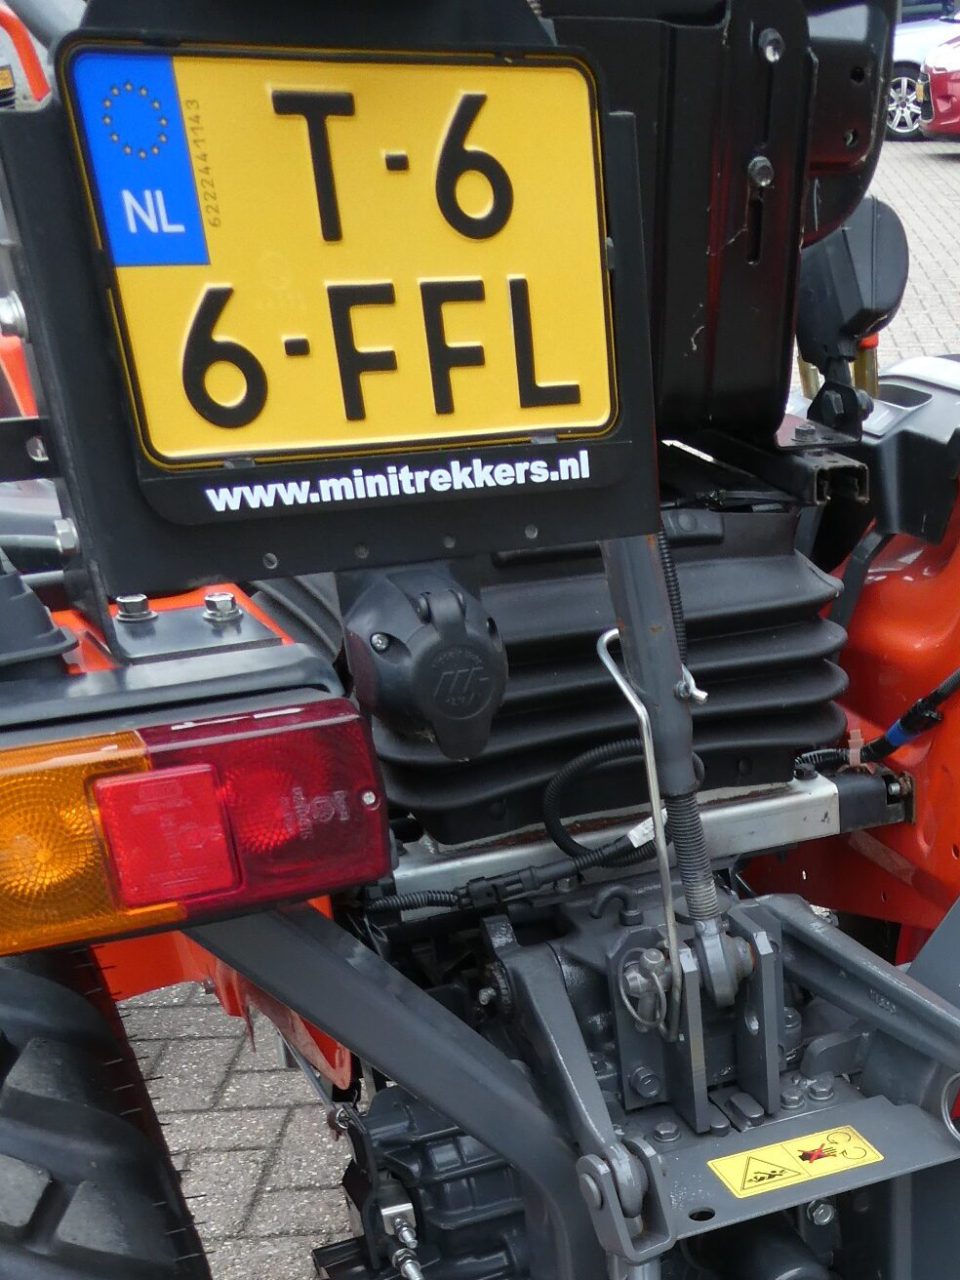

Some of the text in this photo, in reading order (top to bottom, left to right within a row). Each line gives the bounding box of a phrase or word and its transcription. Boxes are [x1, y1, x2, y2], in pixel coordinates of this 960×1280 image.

[121, 189, 186, 233] NL
[185, 99, 222, 228] 6222441143
[271, 91, 514, 242] T-6
[181, 277, 581, 429] 6-FFL
[206, 450, 590, 512] www.minitrekkers.nl
